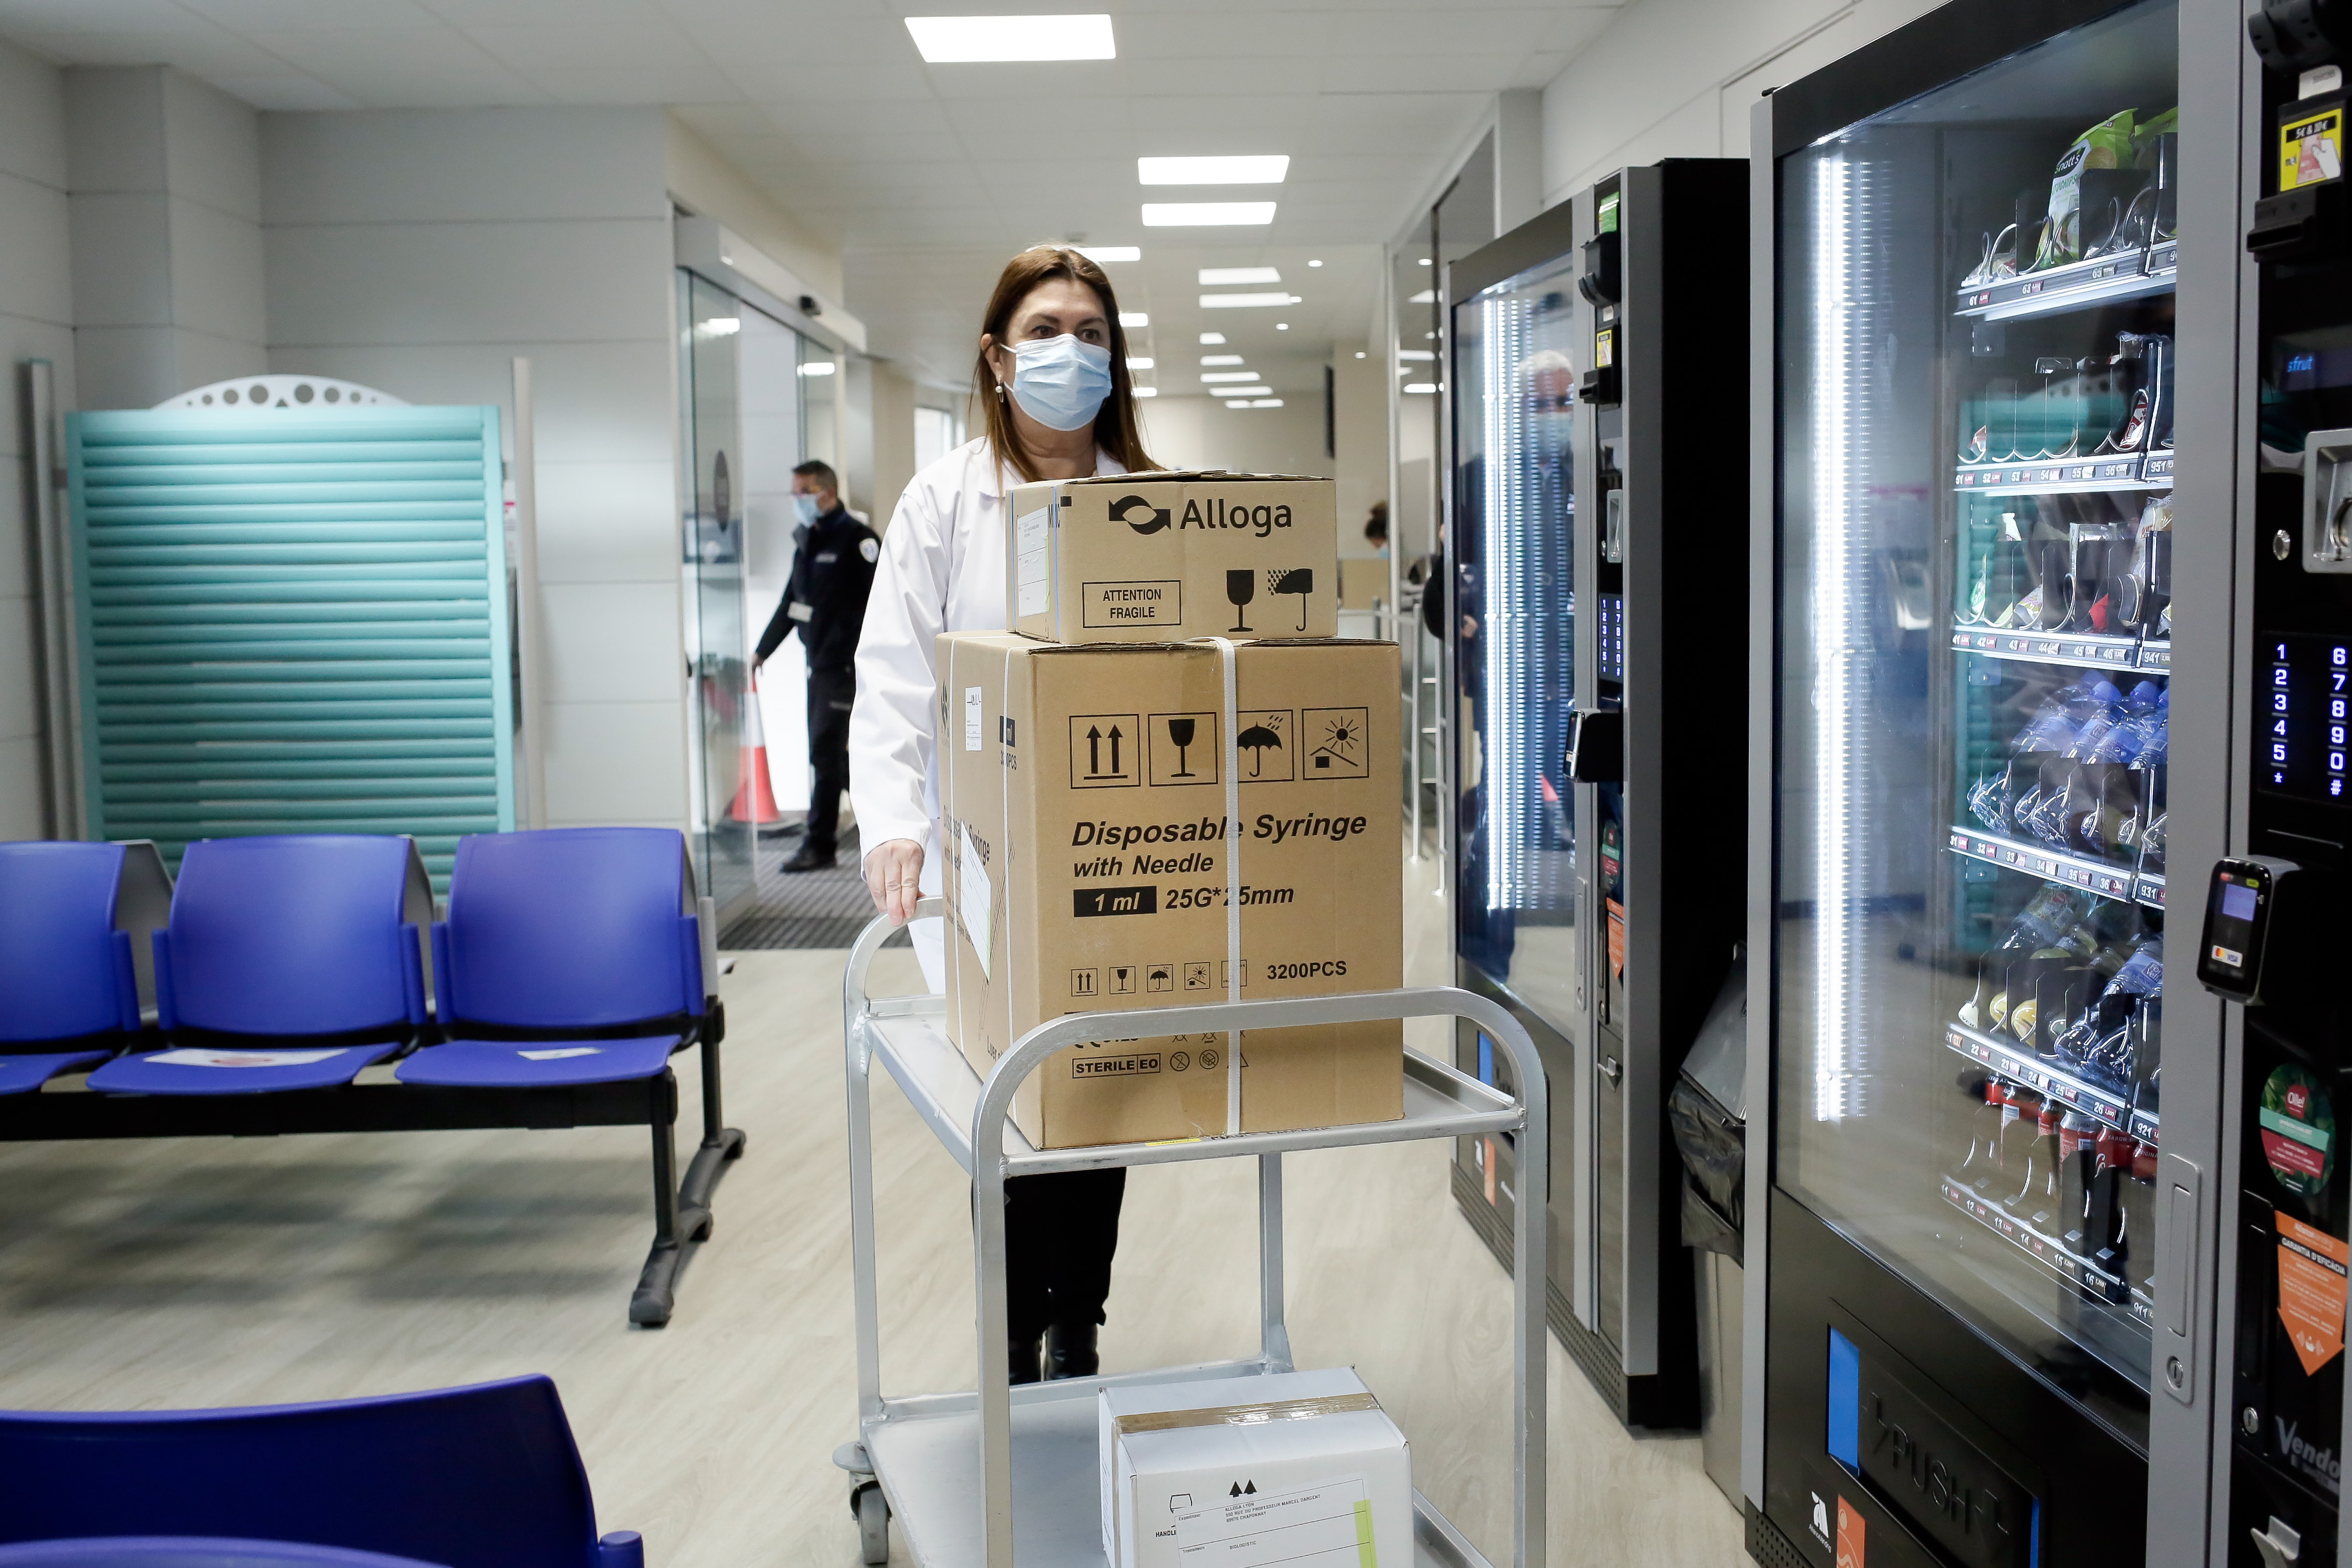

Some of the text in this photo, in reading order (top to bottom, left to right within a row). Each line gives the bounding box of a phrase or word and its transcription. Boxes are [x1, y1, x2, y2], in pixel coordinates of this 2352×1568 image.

[2022, 283, 2032, 295] 63
[1955, 474, 1964, 485] 51
[1982, 472, 1991, 483] 52
[2011, 471, 2020, 482] 53
[2040, 470, 2049, 480] 54
[2072, 468, 2081, 478] 55
[2105, 465, 2116, 476] 56
[2150, 461, 2166, 472] 951
[1180, 497, 1292, 538] Alloga
[1102, 589, 1162, 603] ATTENTION
[1109, 606, 1155, 620] FRAGILE
[1952, 634, 1960, 645] 41
[1977, 637, 1986, 647] 42
[2009, 640, 2018, 650] 43
[2039, 643, 2048, 653] 44
[2074, 646, 2084, 656] 45
[2103, 649, 2113, 660] 46
[2144, 653, 2160, 664] 941
[2276, 643, 2346, 665] 1 6
[2275, 669, 2346, 691] 2 7
[2274, 694, 2345, 717] 3 8
[2274, 720, 2345, 744] 4 9
[2273, 744, 2344, 770] 5 0
[2330, 779, 2342, 795] #
[1254, 812, 1367, 844] Syringe
[1074, 853, 1213, 877] with Needle
[1949, 835, 1958, 846] 31
[1977, 843, 1986, 854] 32
[2006, 851, 2015, 862] 33
[2036, 861, 2045, 872] 34
[2068, 869, 2078, 881] 35
[2100, 878, 2110, 890] 36
[2141, 886, 2157, 899] 931
[1095, 892, 1140, 912] 1 ml
[1267, 960, 1348, 980] 3200PCS
[1076, 1059, 1158, 1074] STERILE EO
[1970, 1044, 1980, 1054] 22
[2000, 1058, 2010, 1070] 23
[2028, 1071, 2037, 1083] 24
[2055, 1084, 2065, 1096] 25
[2094, 1102, 2104, 1115] 26
[2137, 1123, 2152, 1138] 921
[1941, 1184, 1949, 1196] 11
[1966, 1200, 1974, 1211] 12
[1994, 1217, 2002, 1229] 13
[2021, 1233, 2030, 1246] 14
[2054, 1254, 2064, 1266] 15
[2084, 1273, 2094, 1286] 16
[2134, 1302, 2148, 1319] 911
[1893, 1423, 1970, 1534] PUSH
[1239, 1511, 1266, 1520] CHAPONNAY
[1252, 1502, 1281, 1512] PROFESSEUR
[1230, 1541, 1257, 1550] BIOLOGISTIC
